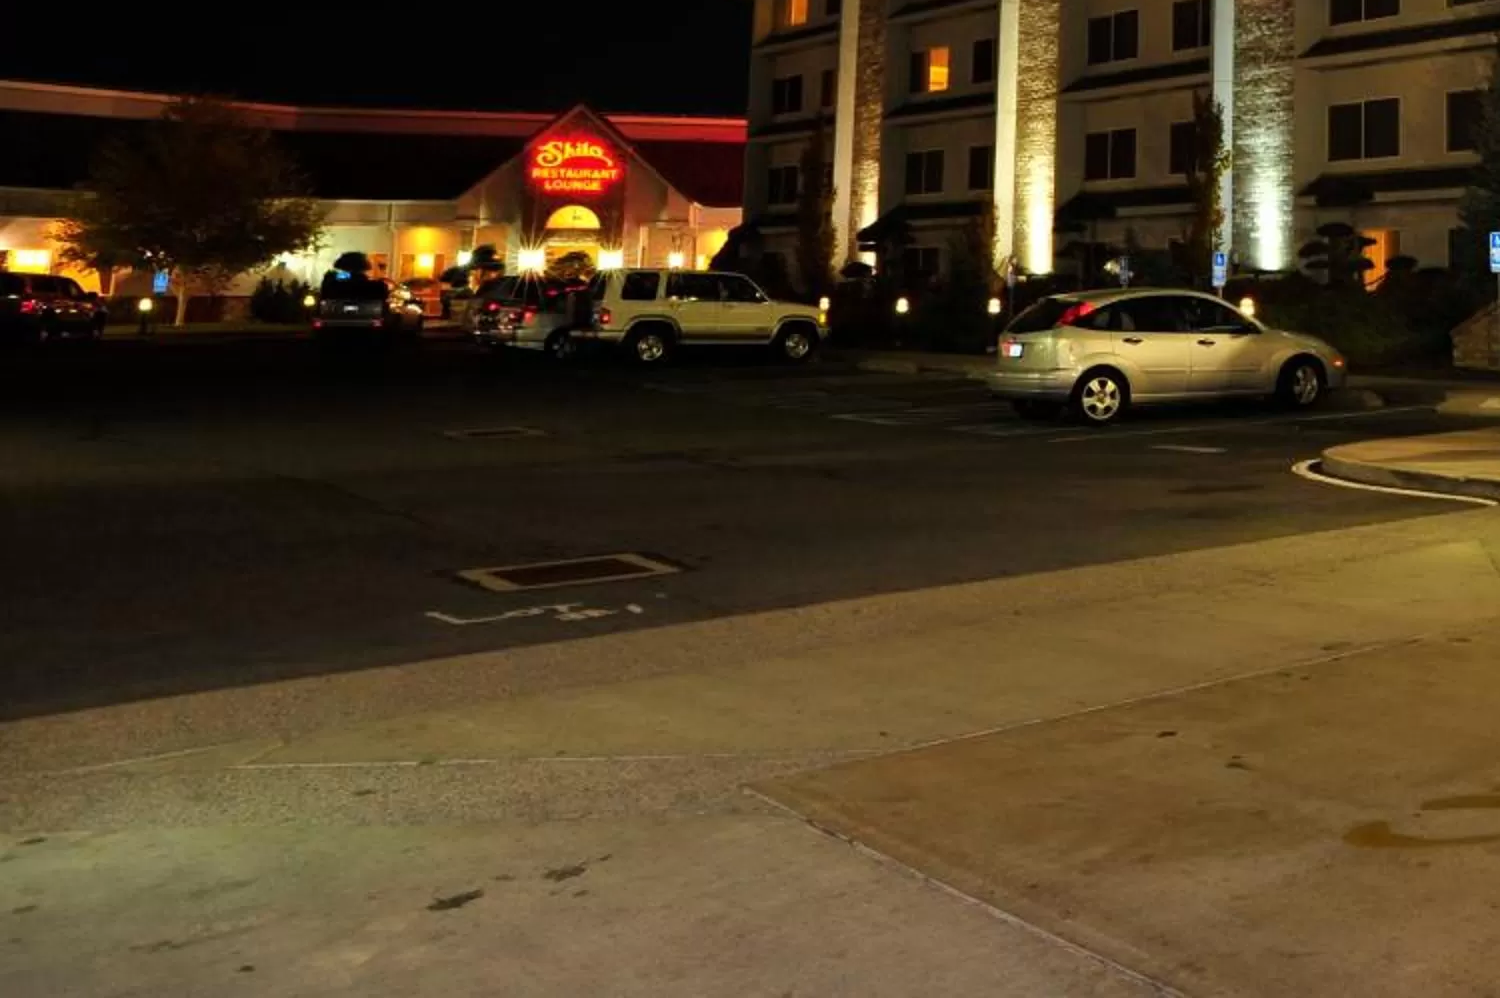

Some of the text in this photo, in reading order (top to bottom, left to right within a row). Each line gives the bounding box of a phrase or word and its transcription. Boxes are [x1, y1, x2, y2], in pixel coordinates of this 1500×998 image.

[536, 141, 613, 167] Shilo
[532, 168, 617, 179] RESTAURANT
[544, 180, 602, 191] LOUNGE
